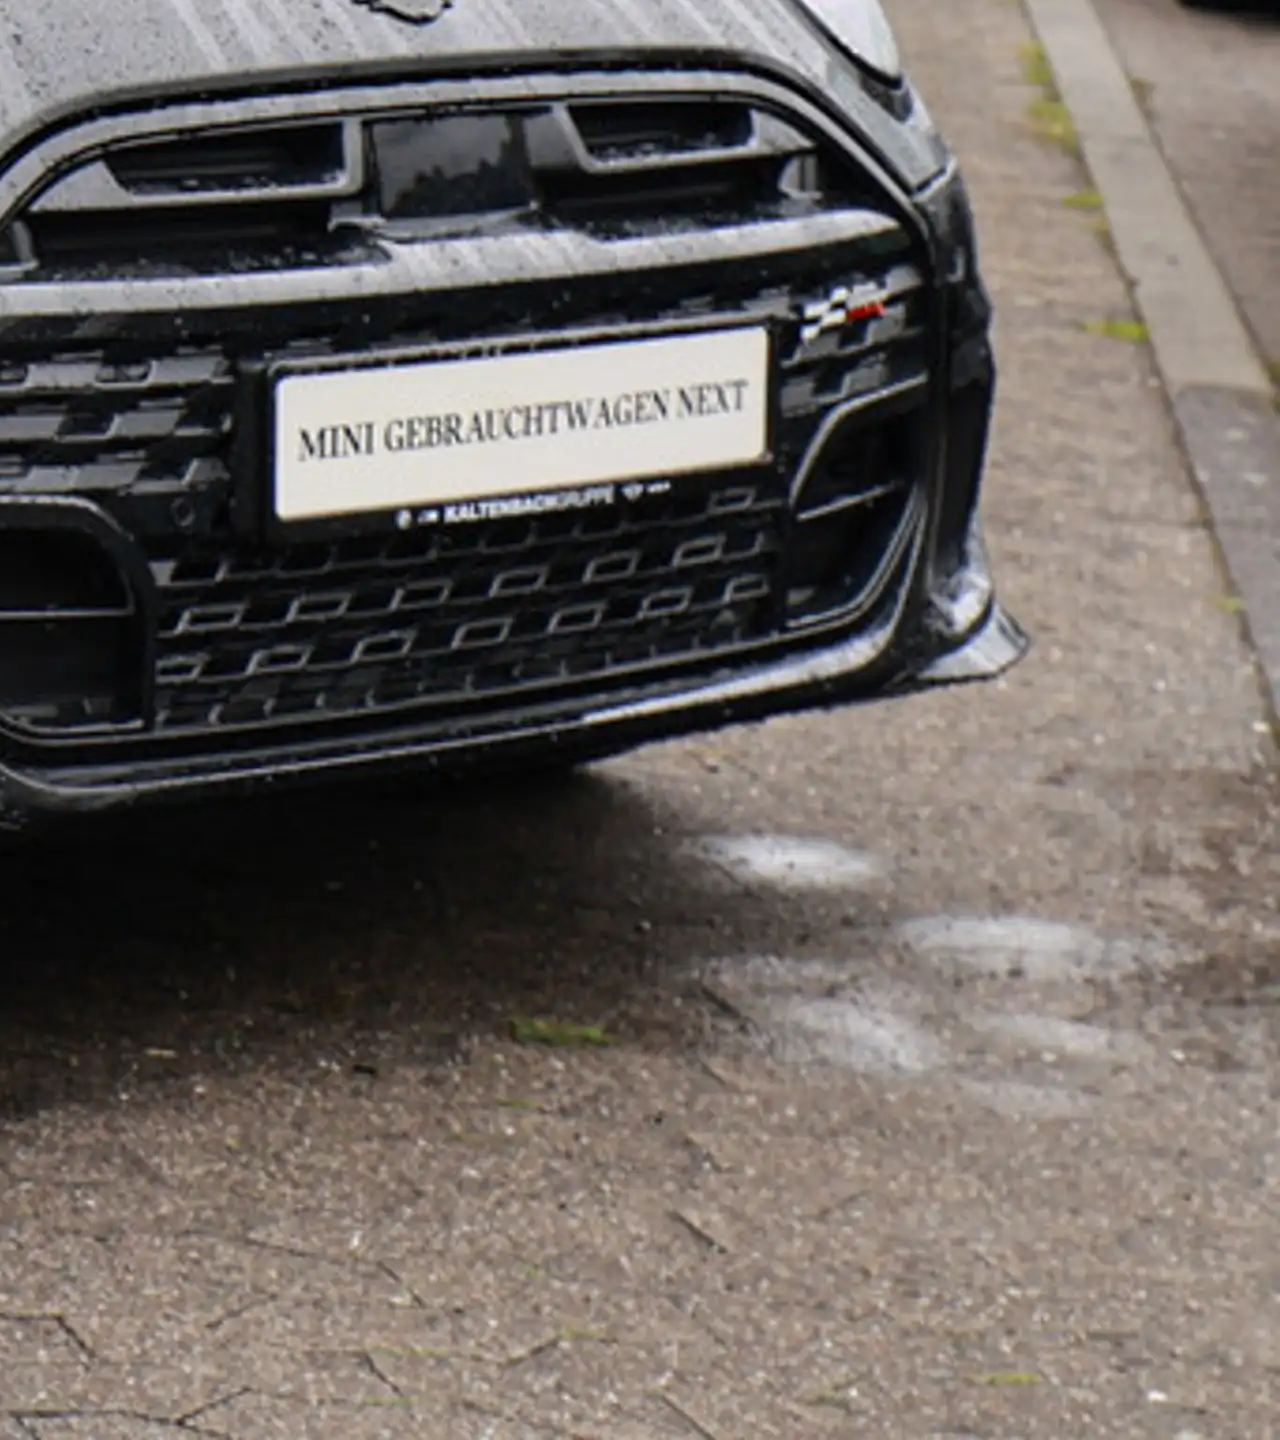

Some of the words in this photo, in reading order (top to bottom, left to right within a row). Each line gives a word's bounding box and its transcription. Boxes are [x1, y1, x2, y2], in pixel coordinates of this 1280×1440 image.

[298, 422, 374, 461] MINI
[384, 389, 670, 453] GEBRAUCHTWAGEN
[676, 379, 749, 418] NEXT
